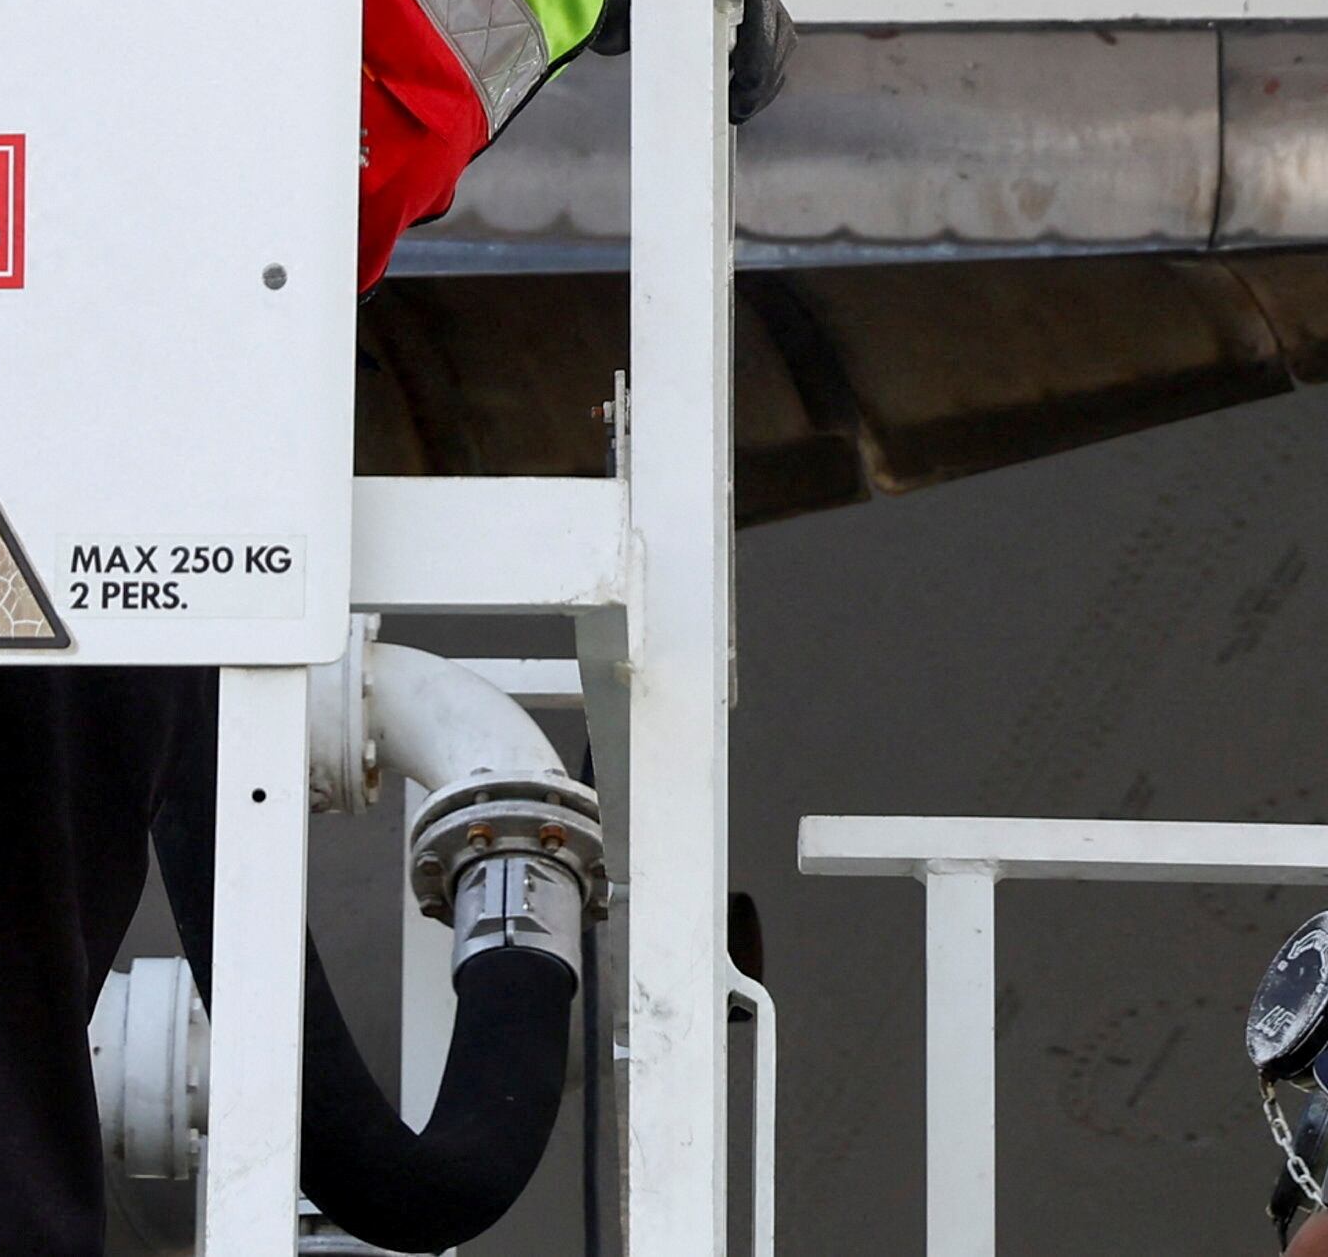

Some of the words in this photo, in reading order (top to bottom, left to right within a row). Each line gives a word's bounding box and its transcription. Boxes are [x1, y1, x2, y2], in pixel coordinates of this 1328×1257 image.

[71, 546, 159, 573] MAX
[170, 546, 234, 574] 250
[245, 546, 292, 574] KG
[71, 582, 89, 609] 2
[101, 581, 189, 610] PERS.
